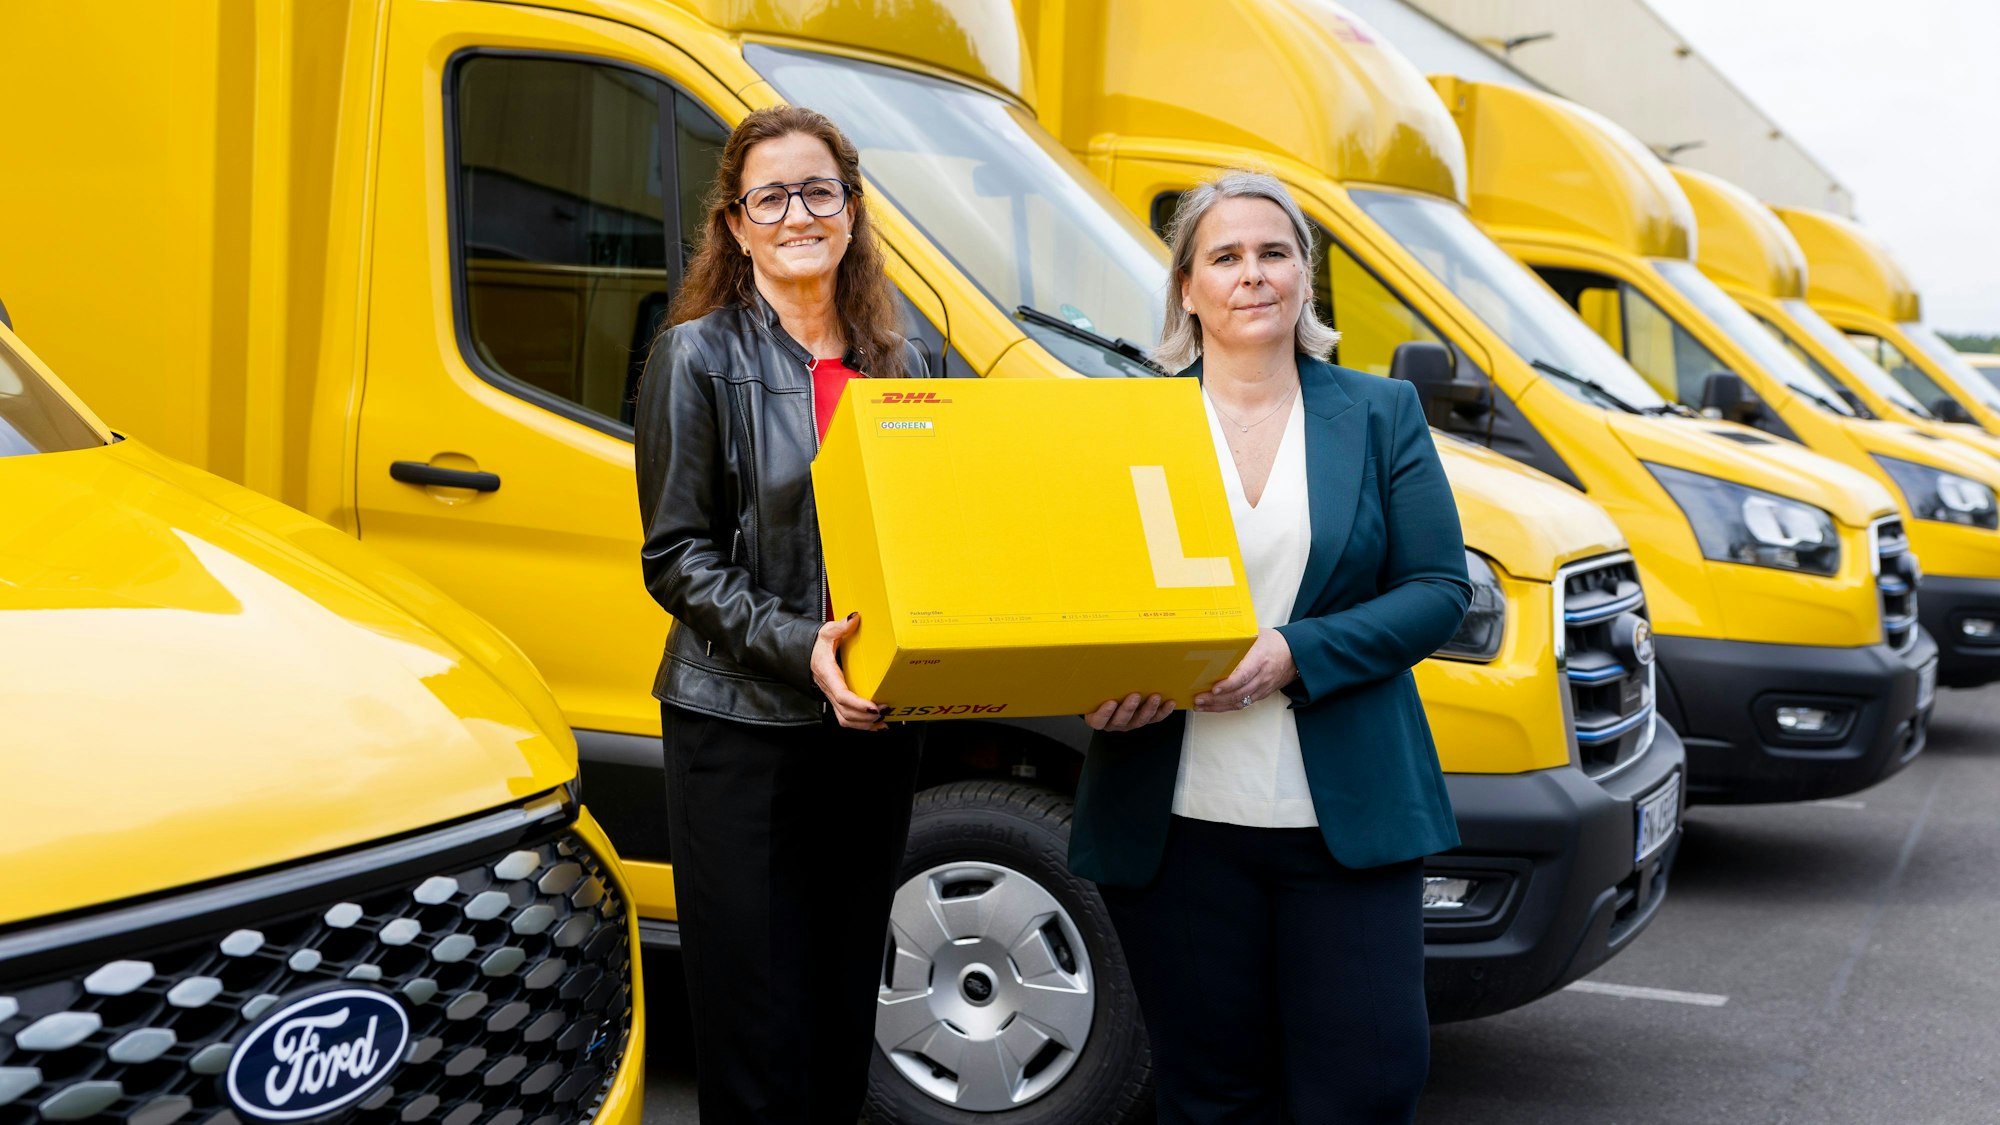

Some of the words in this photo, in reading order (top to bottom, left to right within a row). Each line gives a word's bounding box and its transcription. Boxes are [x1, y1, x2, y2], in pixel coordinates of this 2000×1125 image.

[880, 421, 927, 429] GOGREEN
[882, 392, 941, 404] DHL
[1129, 465, 1236, 588] L
[265, 1006, 380, 1106] Ford
